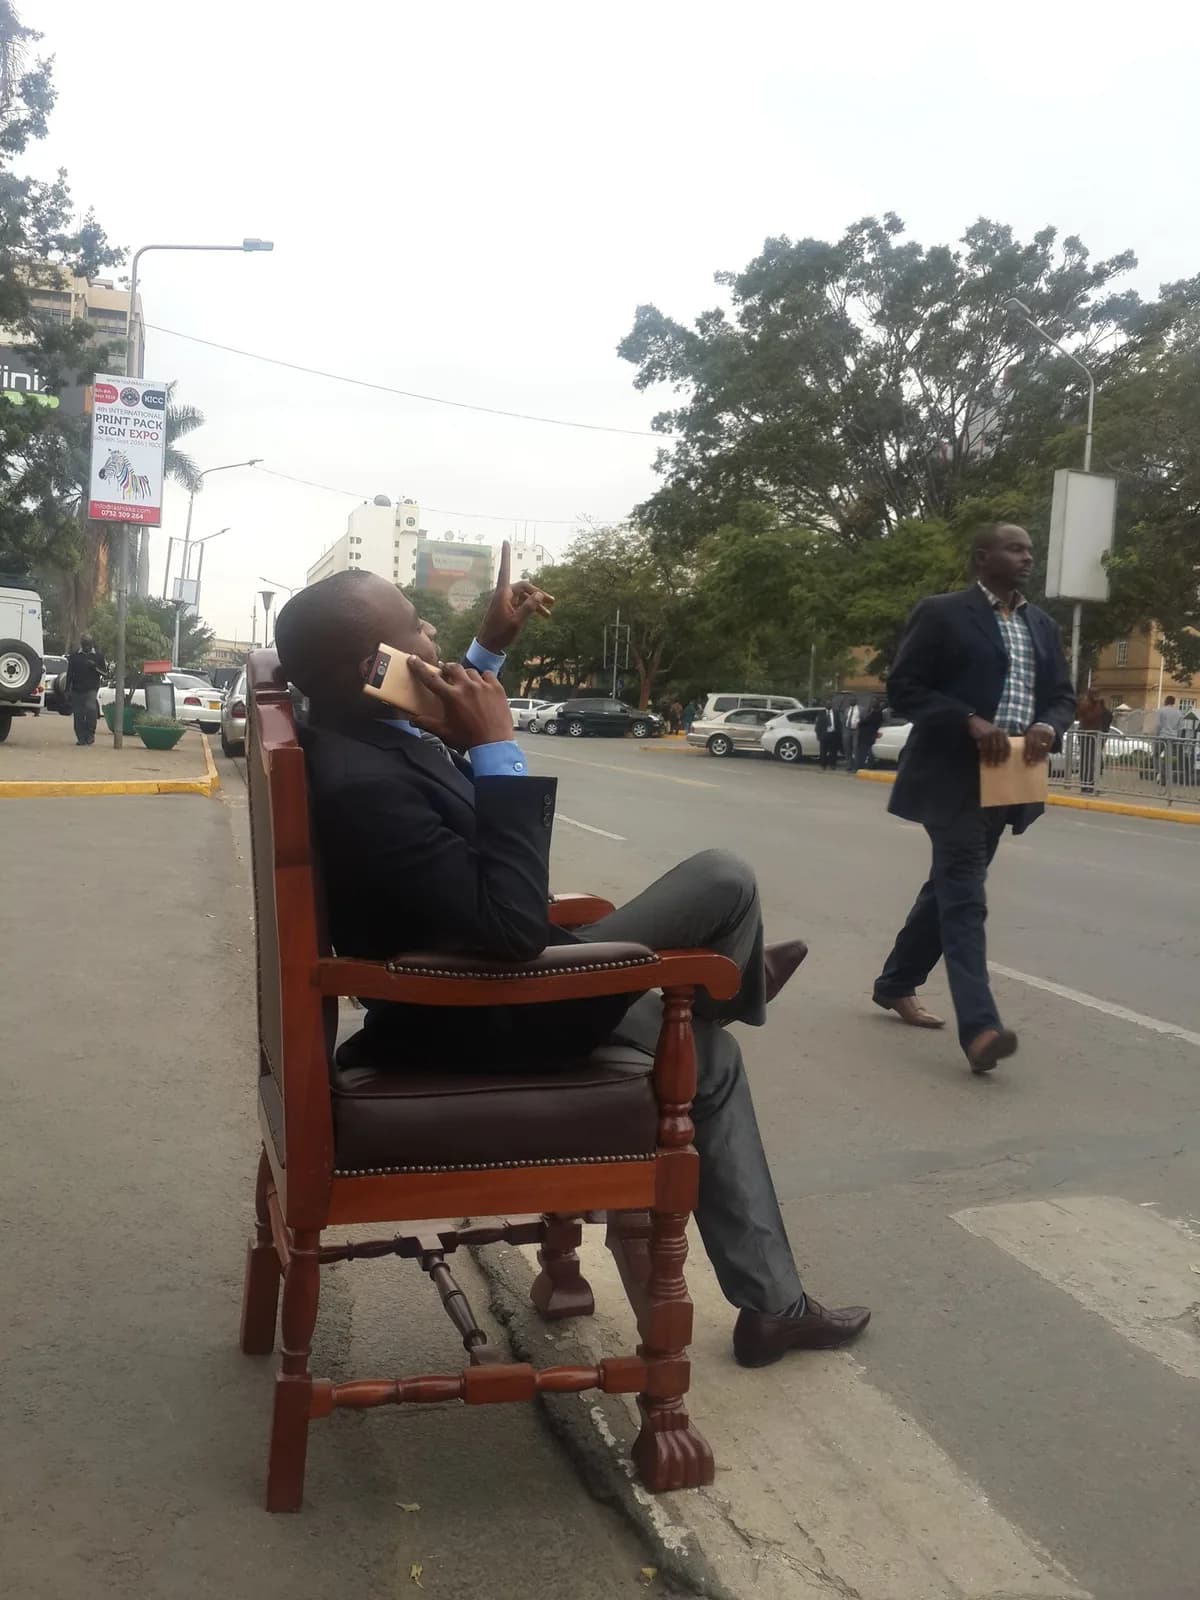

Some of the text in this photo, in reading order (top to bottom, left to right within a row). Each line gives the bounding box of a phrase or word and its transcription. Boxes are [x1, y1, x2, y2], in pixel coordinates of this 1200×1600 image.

[144, 395, 163, 404] KICC
[95, 413, 163, 430] PRINT PACK
[97, 425, 126, 437] SIGN
[129, 429, 159, 441] EXPO
